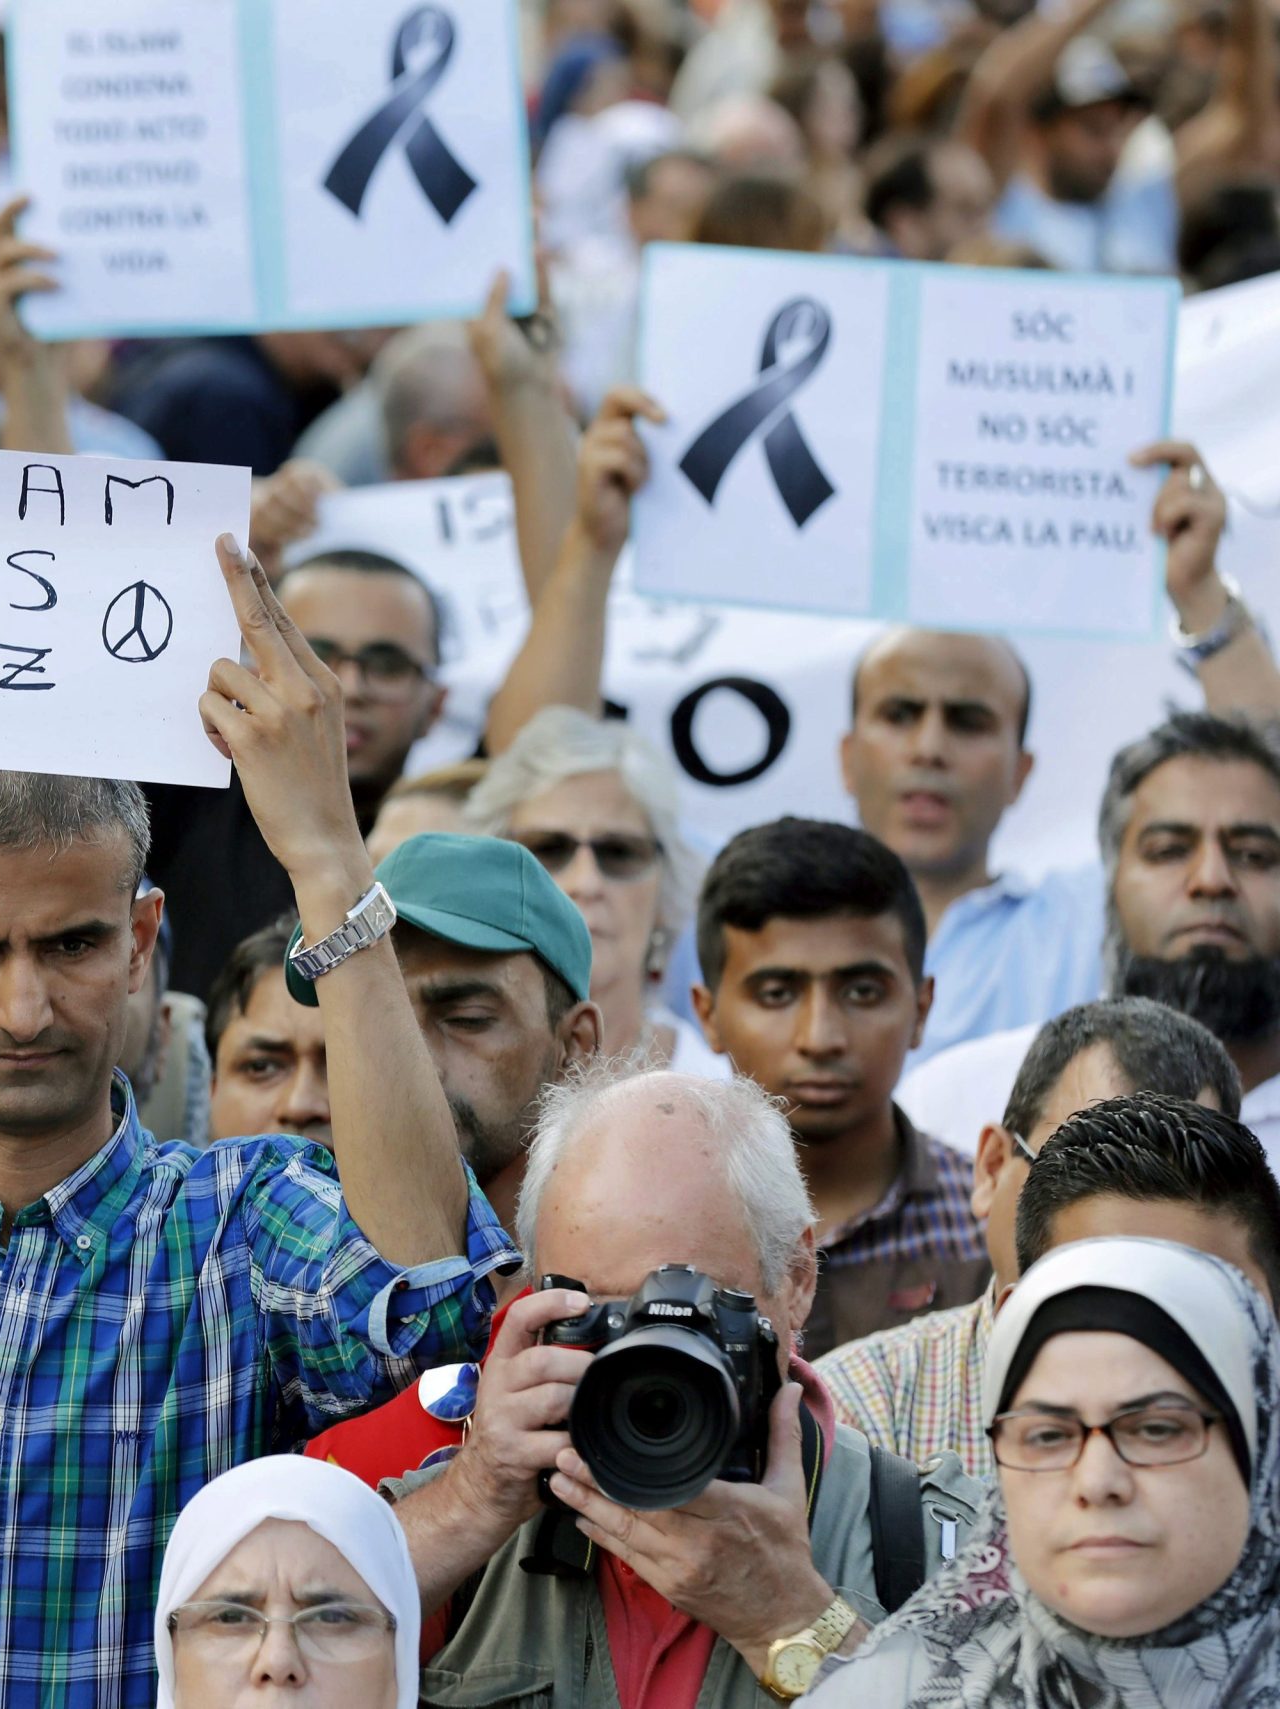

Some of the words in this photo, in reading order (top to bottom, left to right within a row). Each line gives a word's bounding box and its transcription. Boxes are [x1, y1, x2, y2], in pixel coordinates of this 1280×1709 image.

[1123, 366, 1135, 397] I
[978, 412, 1027, 443] NO
[923, 513, 1014, 546] VISCA
[1023, 520, 1061, 548] LA
[648, 1303, 693, 1317] Nikon
